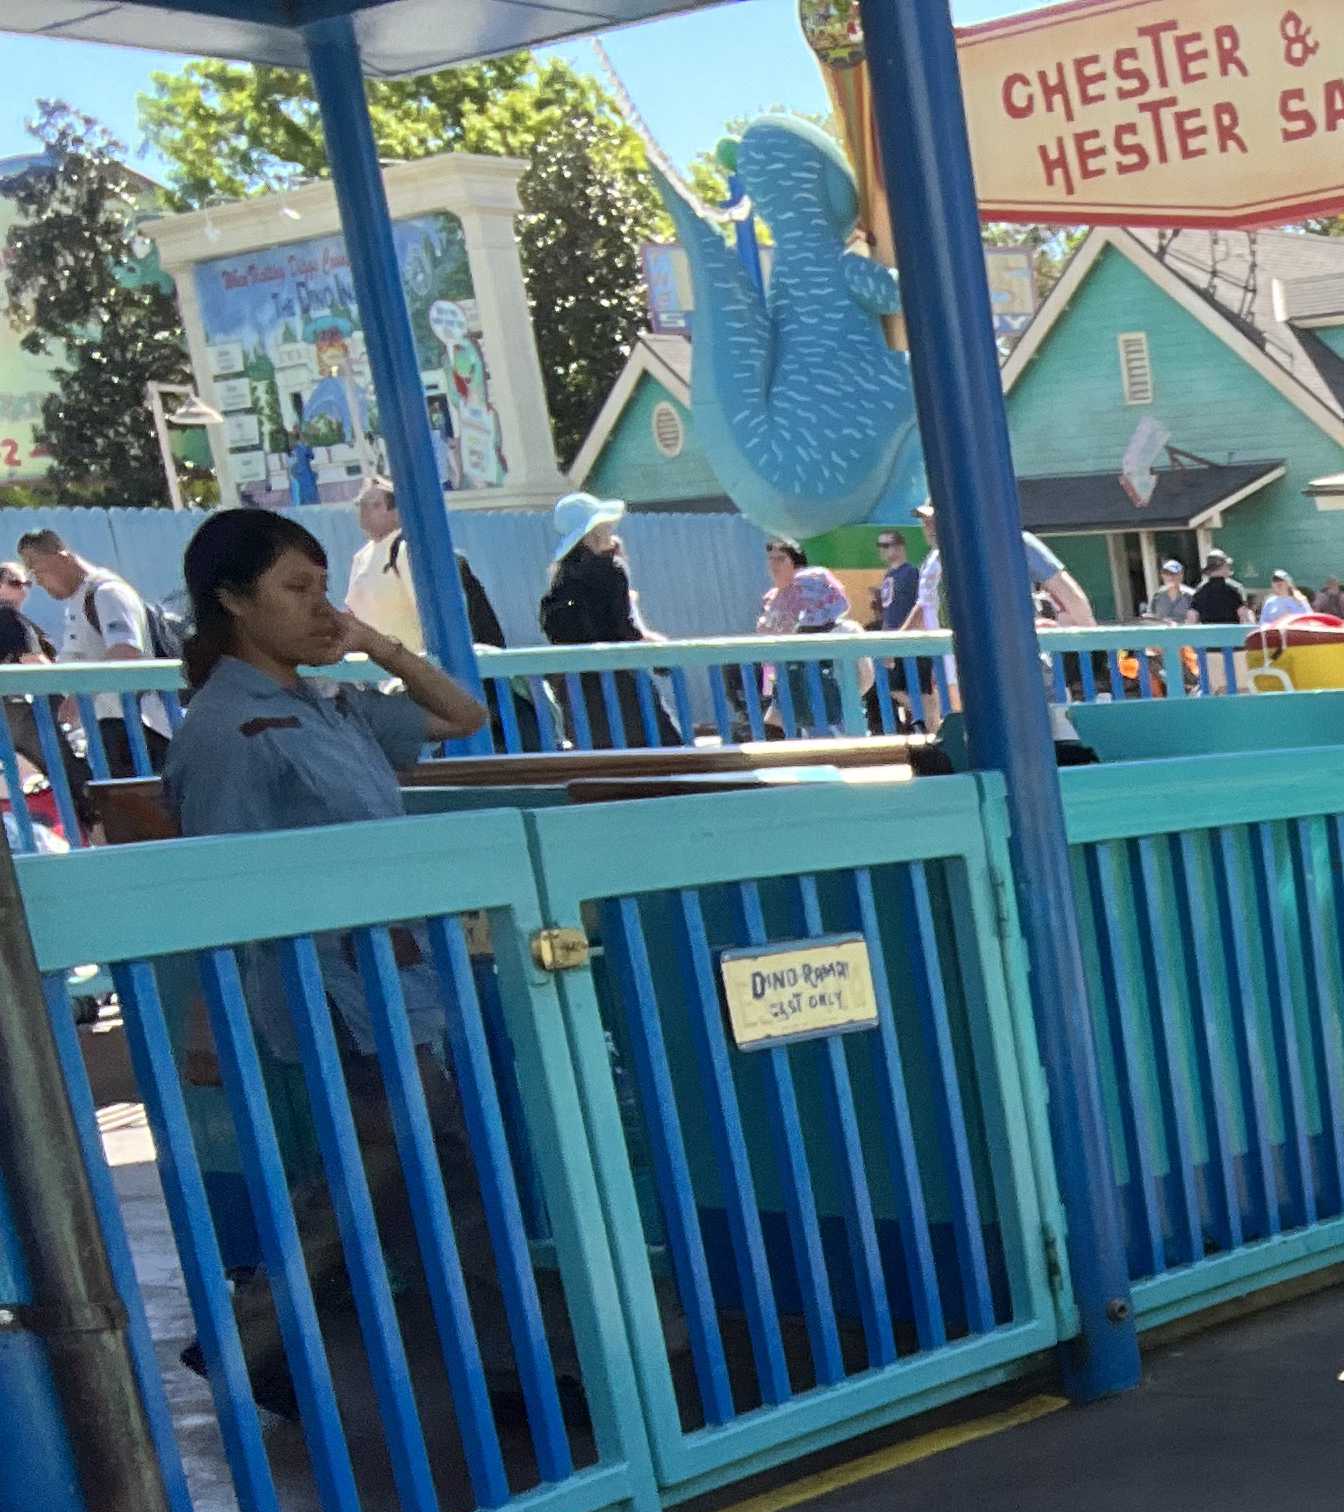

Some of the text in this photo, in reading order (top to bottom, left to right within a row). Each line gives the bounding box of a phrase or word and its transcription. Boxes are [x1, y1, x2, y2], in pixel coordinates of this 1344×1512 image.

[1001, 9, 1321, 122] CHESTER &
[1037, 96, 1248, 196] HESTER
